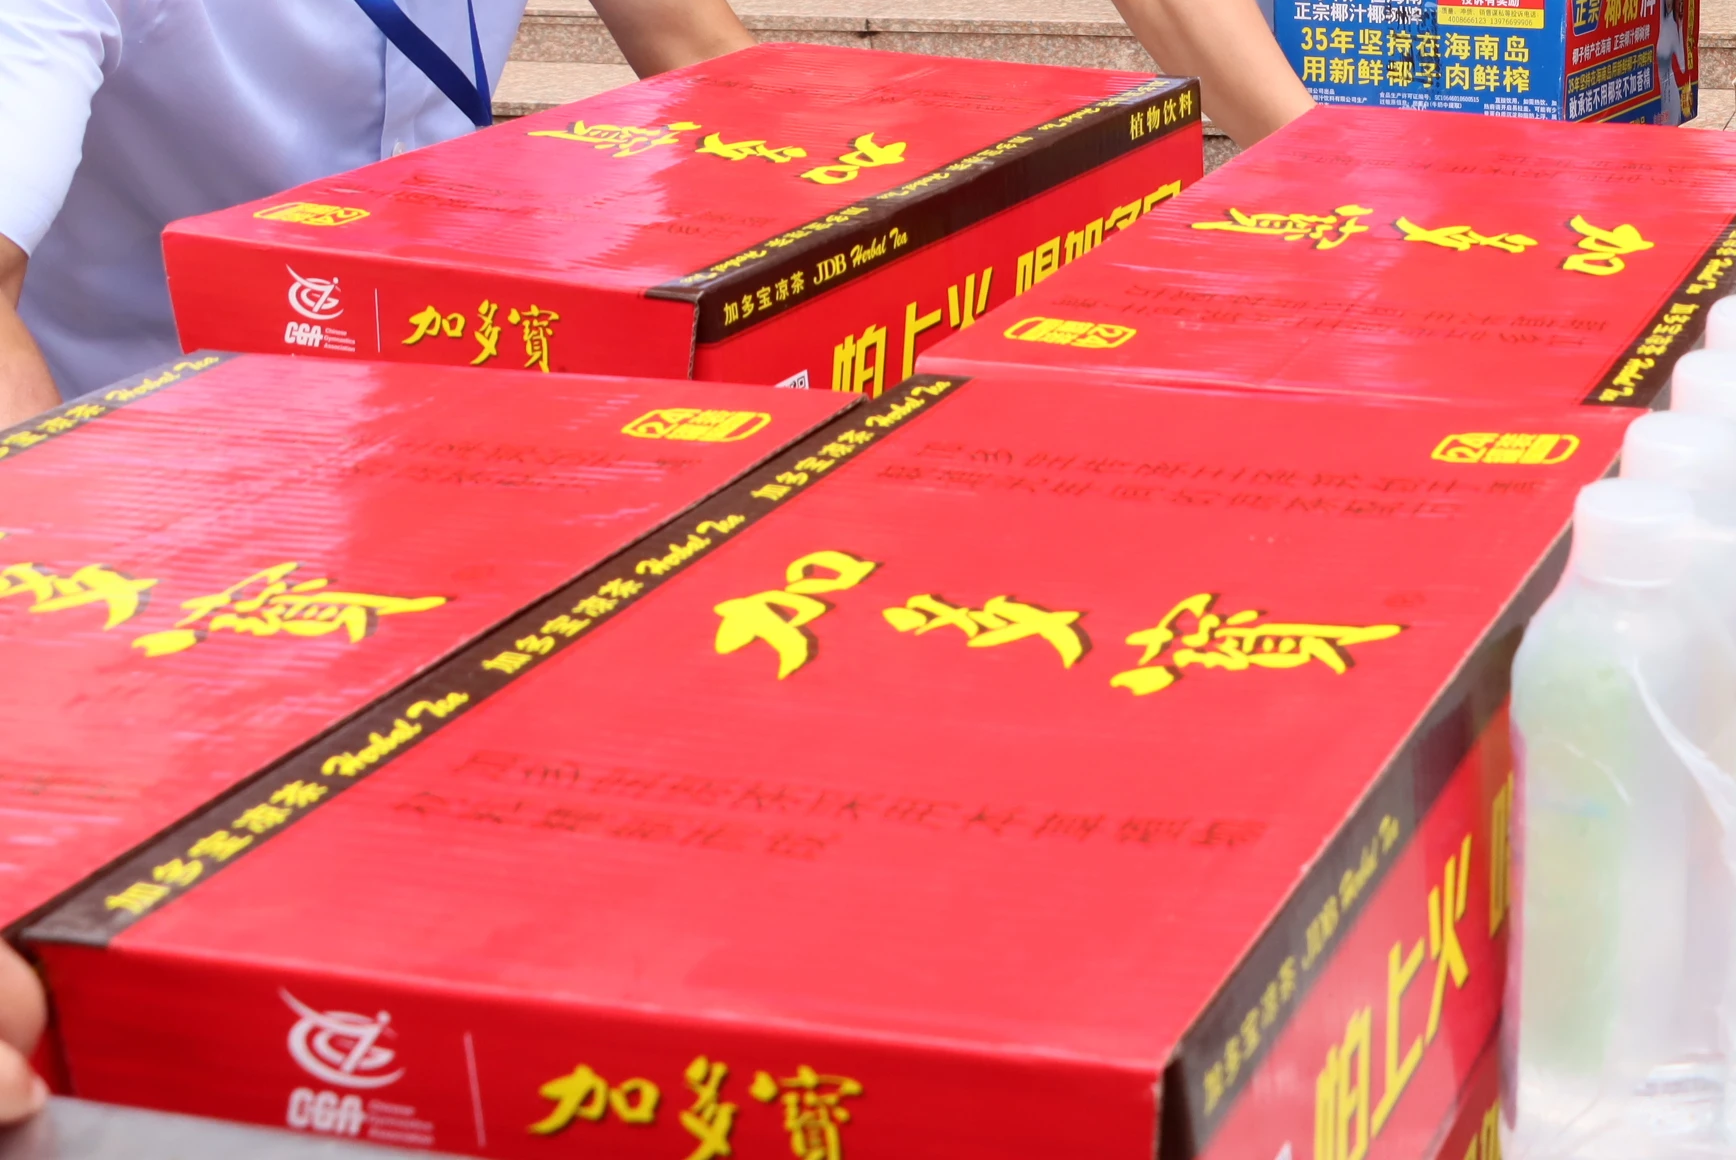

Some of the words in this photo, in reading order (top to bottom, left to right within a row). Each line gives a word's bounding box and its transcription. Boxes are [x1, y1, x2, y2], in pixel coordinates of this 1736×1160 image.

[1294, 1, 1423, 25] 正宗椰汁椰树牌
[1448, 15, 1487, 25] 4008666123
[1300, 26, 1530, 63] 35年坚持在海南岛
[1302, 55, 1531, 94] 用新鲜椰子肉鲜榨
[1569, 68, 1651, 120] 敢承诺不用椰浆不加香精
[1129, 90, 1193, 140] 植物饮料
[723, 270, 805, 327] 加多宝凉茶
[812, 253, 848, 287] JDB
[849, 234, 889, 269] Herbal
[888, 226, 909, 247] Tea
[284, 321, 323, 348] CGA
[750, 429, 875, 501] 加多宝凉茶
[865, 395, 926, 428] Herbal
[482, 577, 643, 676] 加多宝凉茶
[635, 534, 712, 576] Herbal
[106, 781, 328, 918] 加多宝凉茶
[322, 718, 422, 778] Herbal
[1313, 832, 1473, 1160] 怕上火
